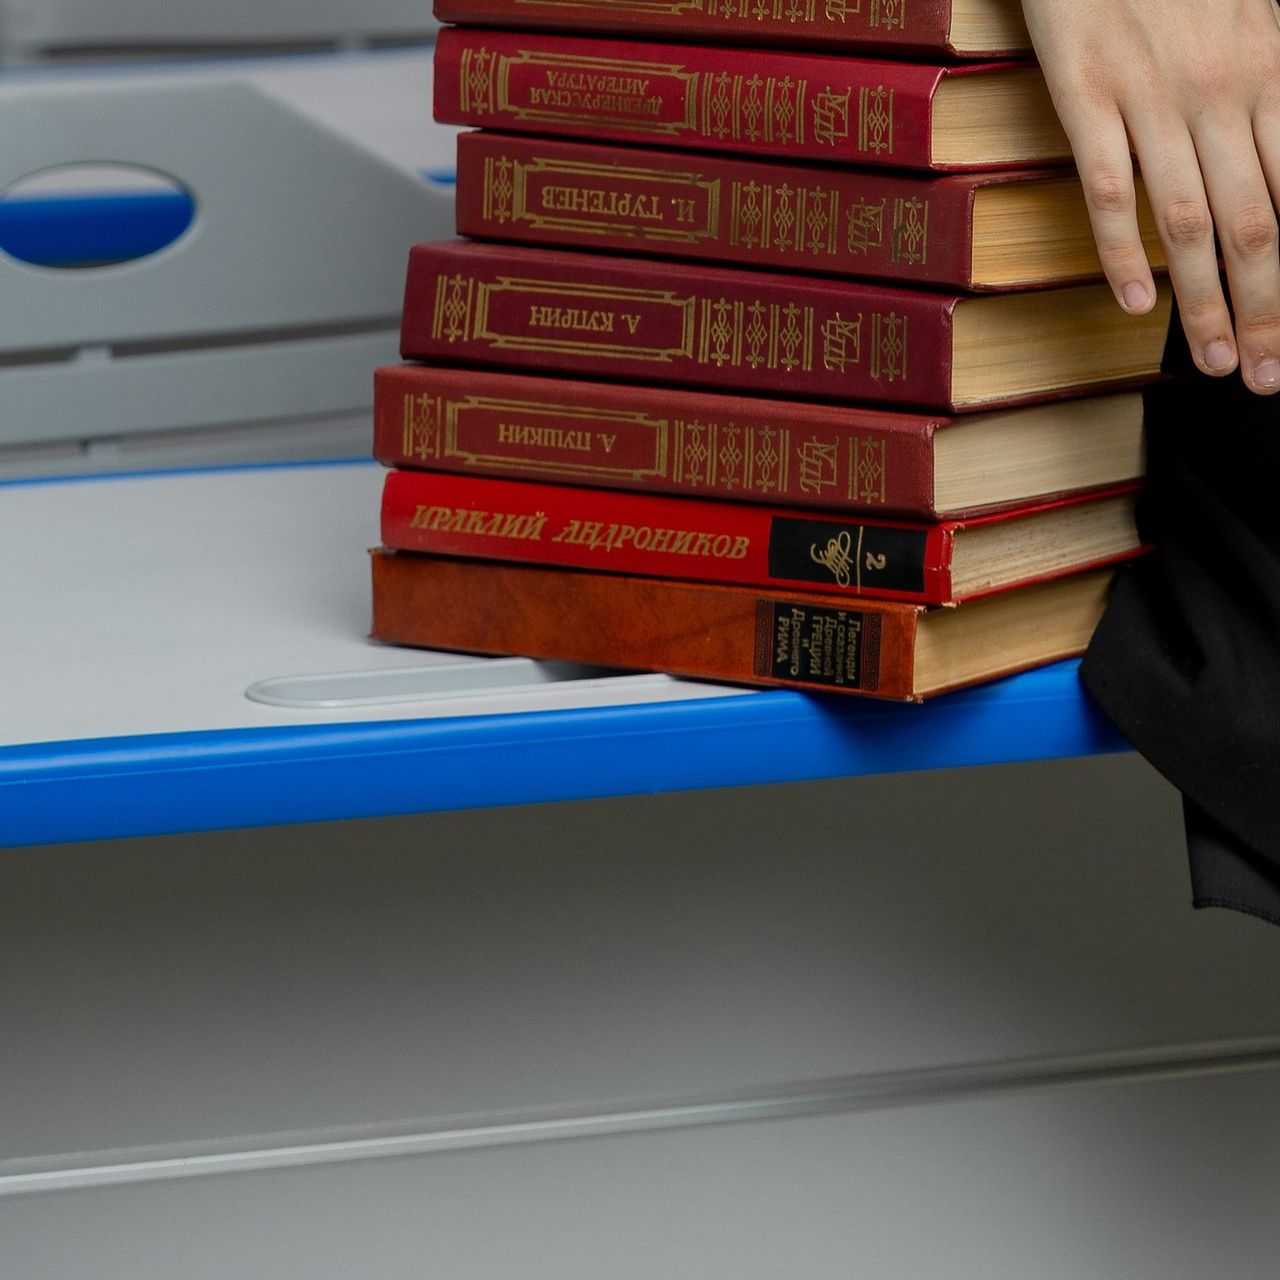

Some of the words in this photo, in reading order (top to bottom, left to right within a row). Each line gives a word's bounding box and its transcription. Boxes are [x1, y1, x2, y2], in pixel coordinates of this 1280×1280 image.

[546, 70, 649, 96] ЛИТЕРАТУРА
[530, 87, 663, 115] ДРЕВНЕРУССКАЯ
[541, 185, 663, 220] ТУРГЕНЕВ
[671, 197, 696, 222] И.
[529, 305, 615, 332] КУПРИН
[621, 313, 641, 334] А.
[498, 423, 591, 451] ПУШКИН
[597, 433, 617, 452] А.
[409, 504, 549, 541] ИРАКЛИЙ
[552, 519, 750, 559] АНДРОНИКОВ
[866, 551, 886, 570] 2
[776, 616, 790, 663] РИМА
[790, 608, 806, 676] Древнего
[809, 615, 824, 675] ГРЕЦИИ
[847, 618, 861, 680] Легенды
[835, 624, 846, 684] сказания
